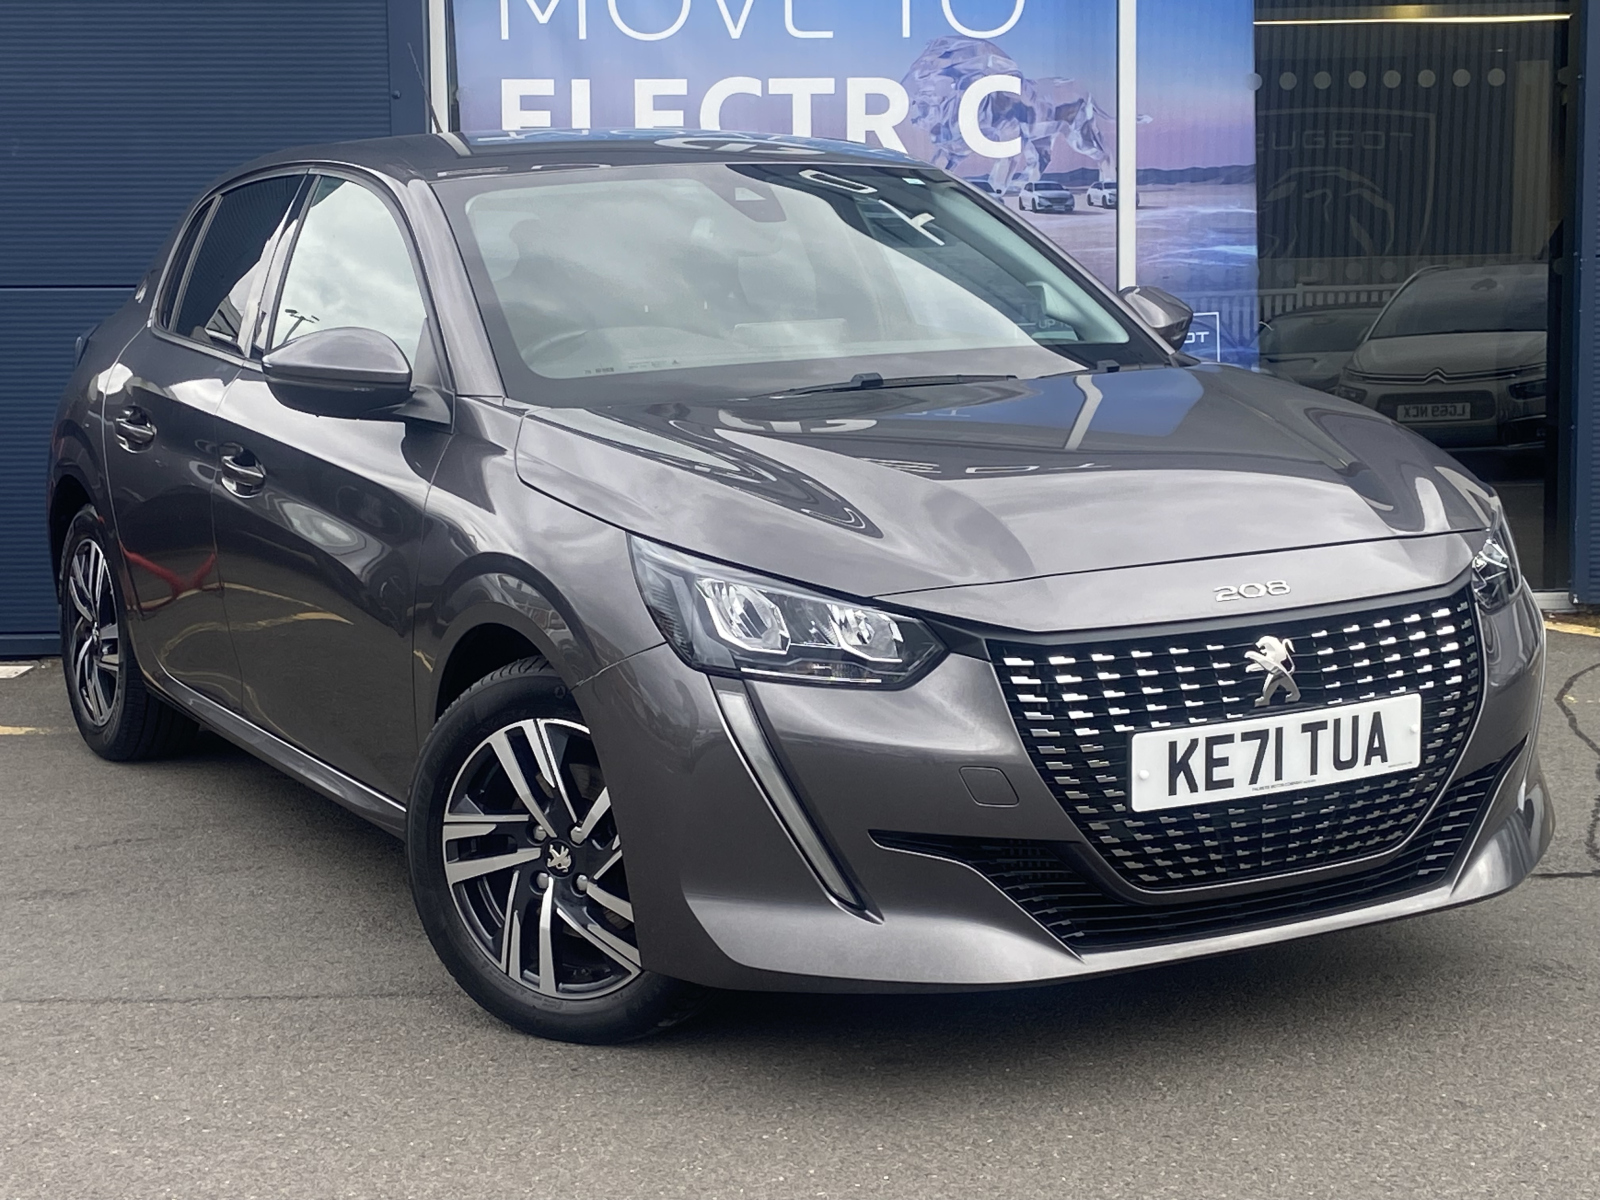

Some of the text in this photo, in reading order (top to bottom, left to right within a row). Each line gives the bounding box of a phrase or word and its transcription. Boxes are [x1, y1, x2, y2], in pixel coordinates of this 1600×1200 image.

[1213, 580, 1291, 602] 208
[1168, 711, 1389, 797] KE71 TUA
